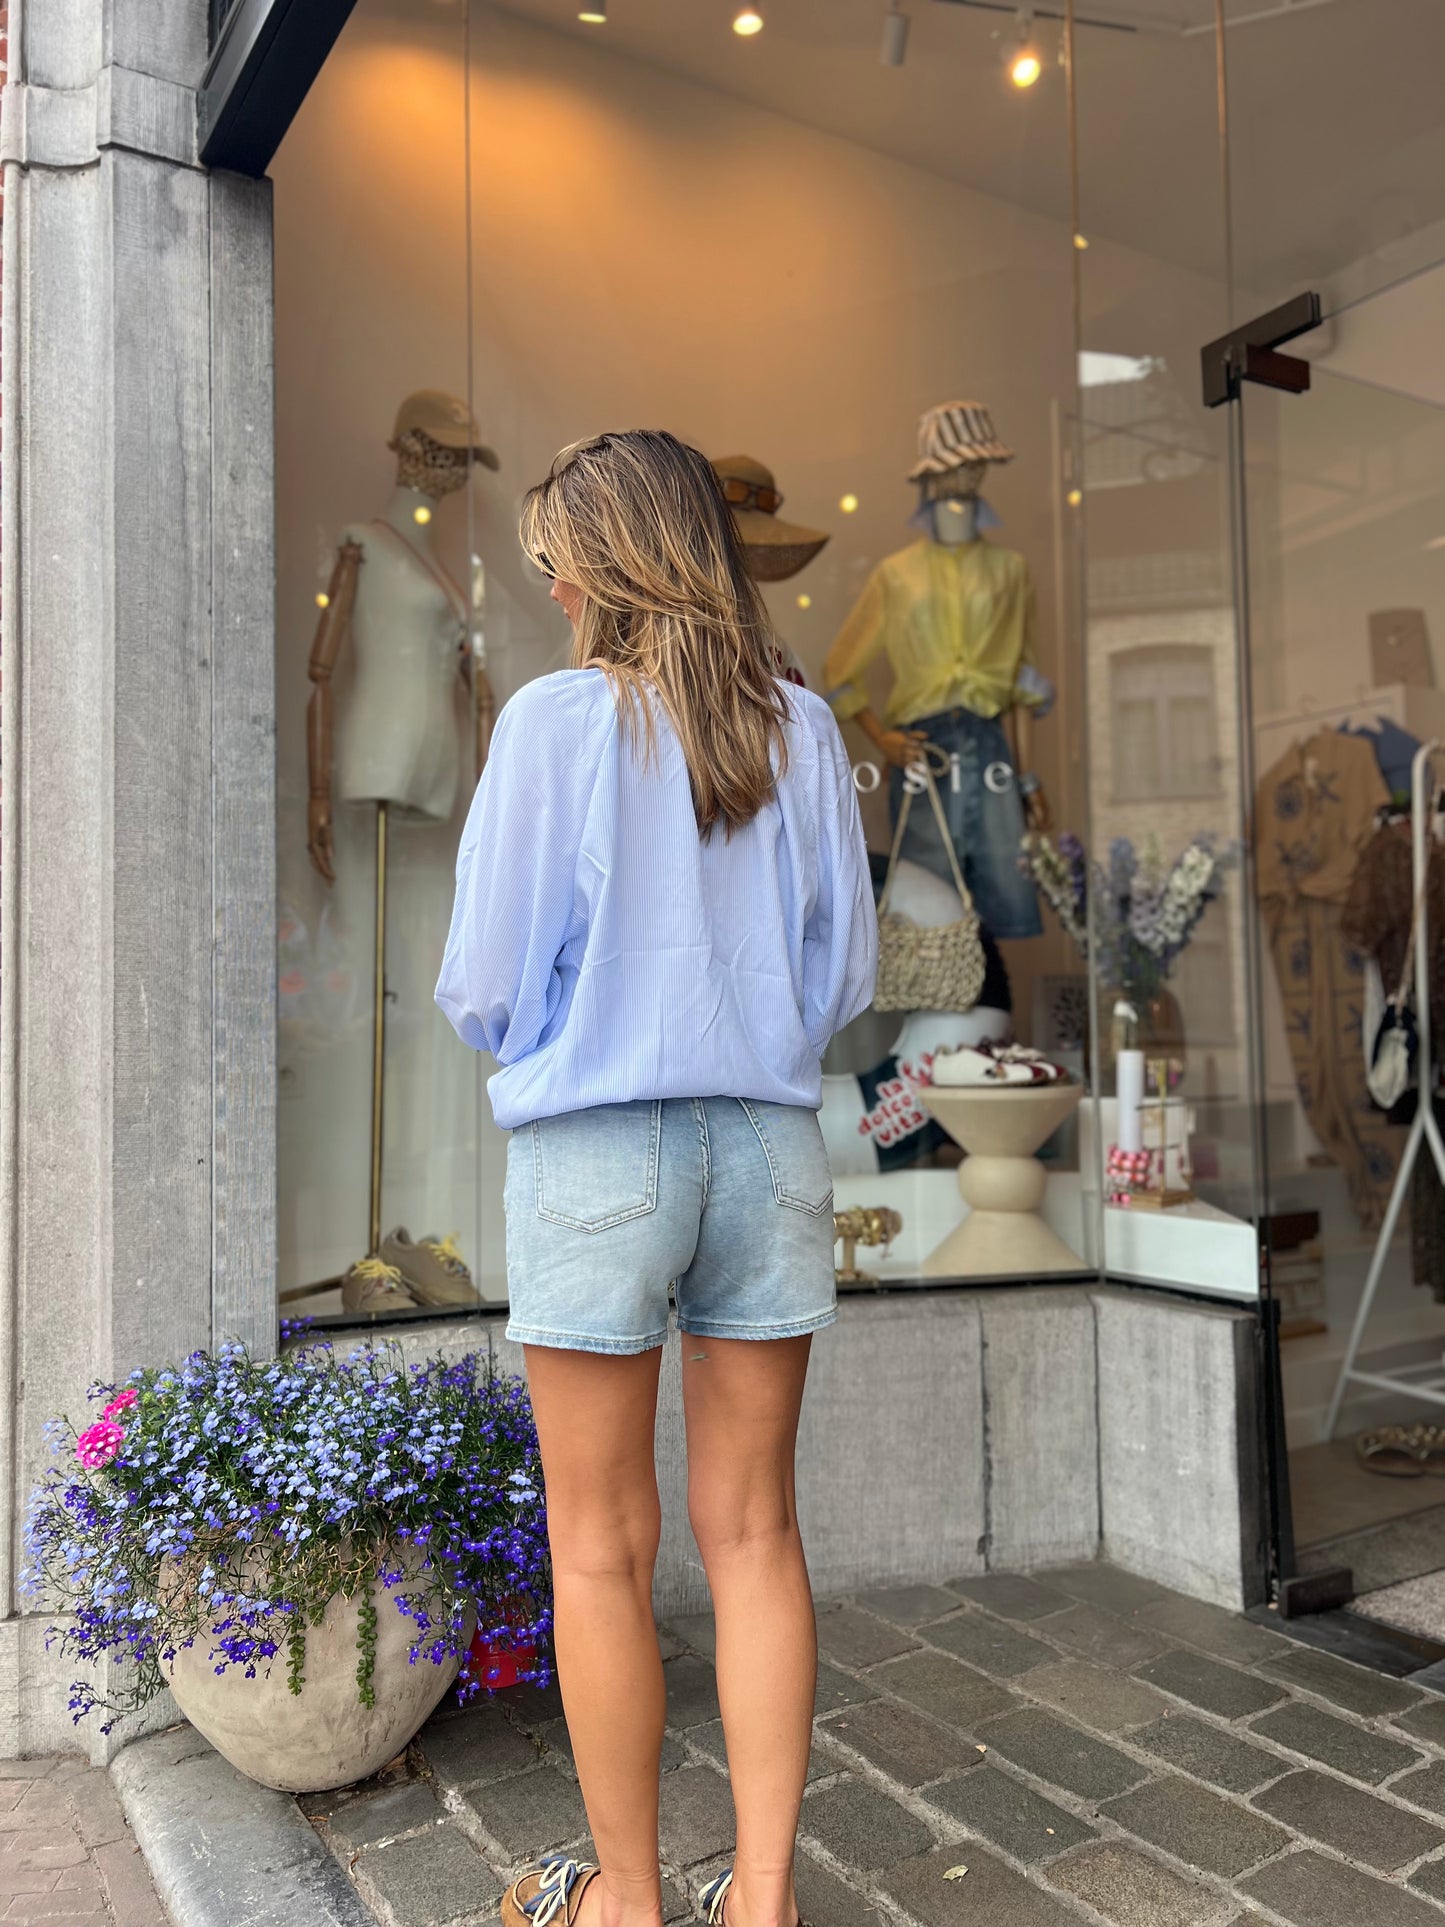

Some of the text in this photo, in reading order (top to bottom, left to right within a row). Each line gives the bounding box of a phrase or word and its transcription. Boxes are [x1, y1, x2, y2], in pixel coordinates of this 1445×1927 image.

[881, 1081, 904, 1098] la
[857, 1094, 912, 1136] dolce
[879, 1110, 924, 1142] vita
